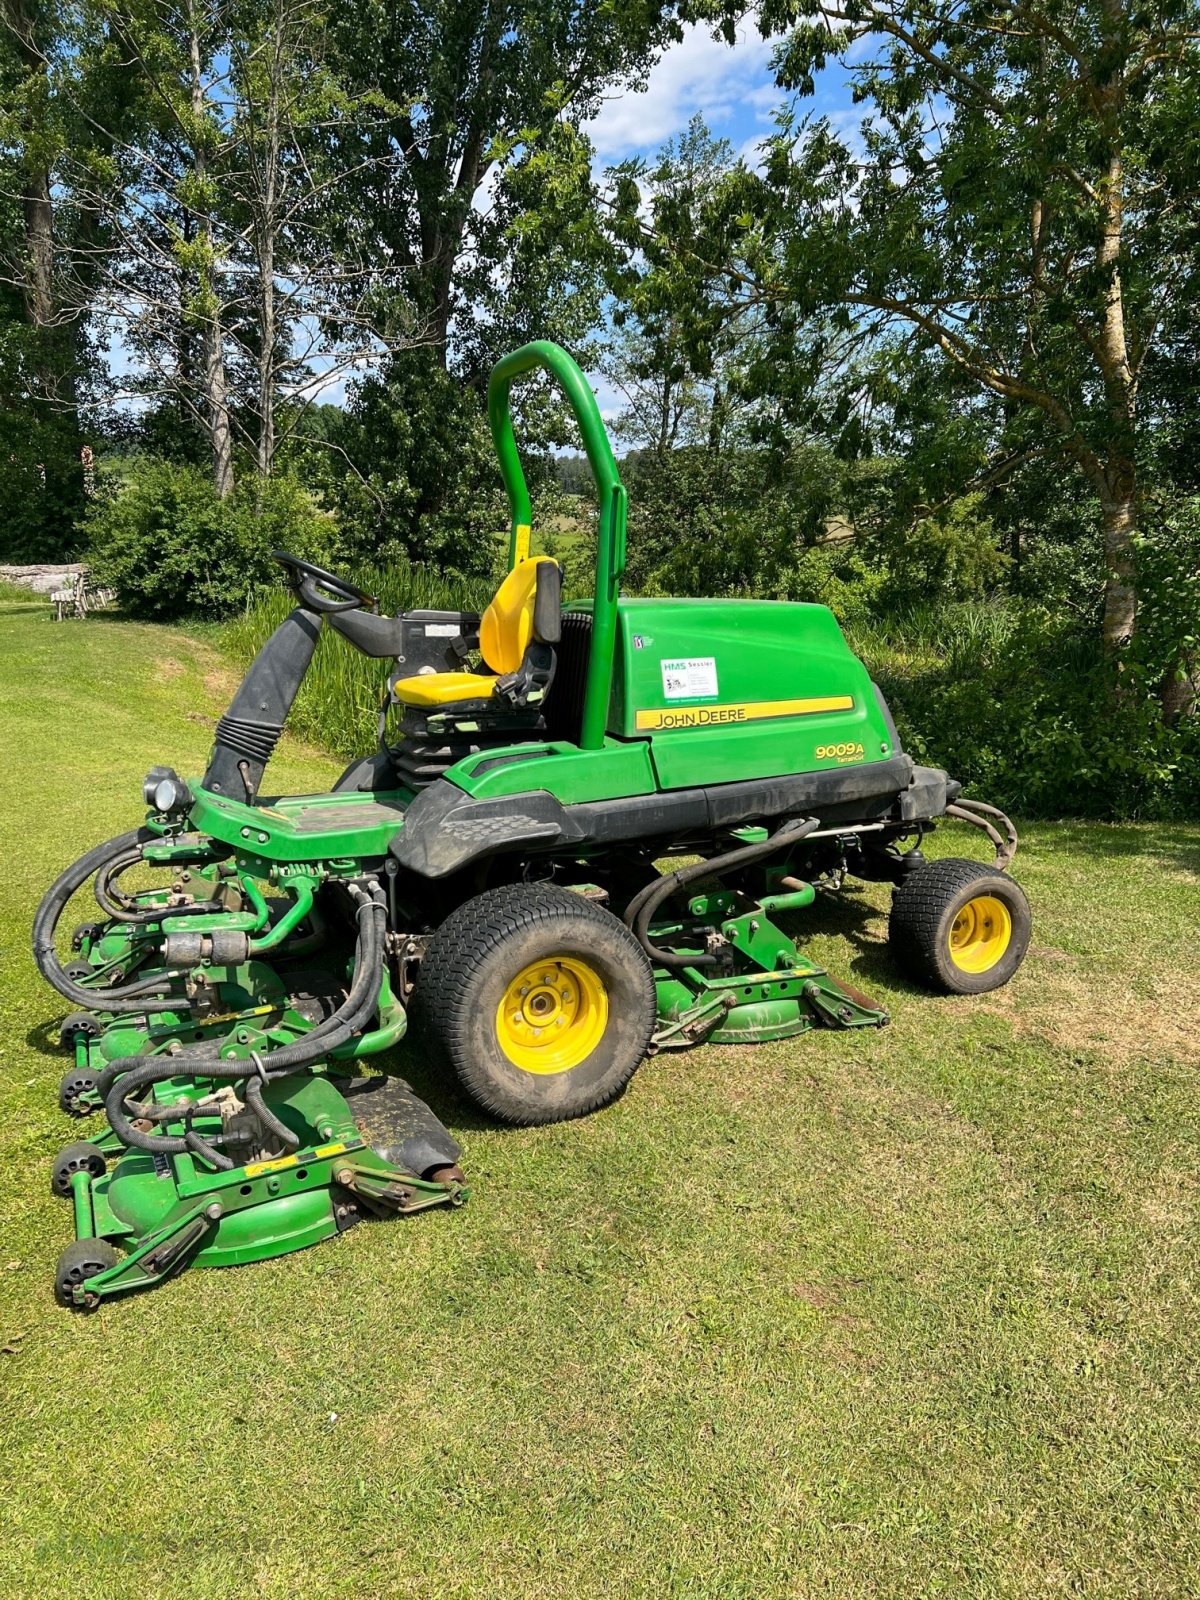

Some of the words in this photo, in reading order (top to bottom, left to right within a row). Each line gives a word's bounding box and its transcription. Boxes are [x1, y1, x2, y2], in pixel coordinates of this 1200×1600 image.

[664, 662, 686, 671] HMS
[688, 660, 712, 668] Sessler
[655, 713, 695, 728] JOHN
[698, 708, 746, 724] DEERE
[816, 742, 864, 759] 9009A
